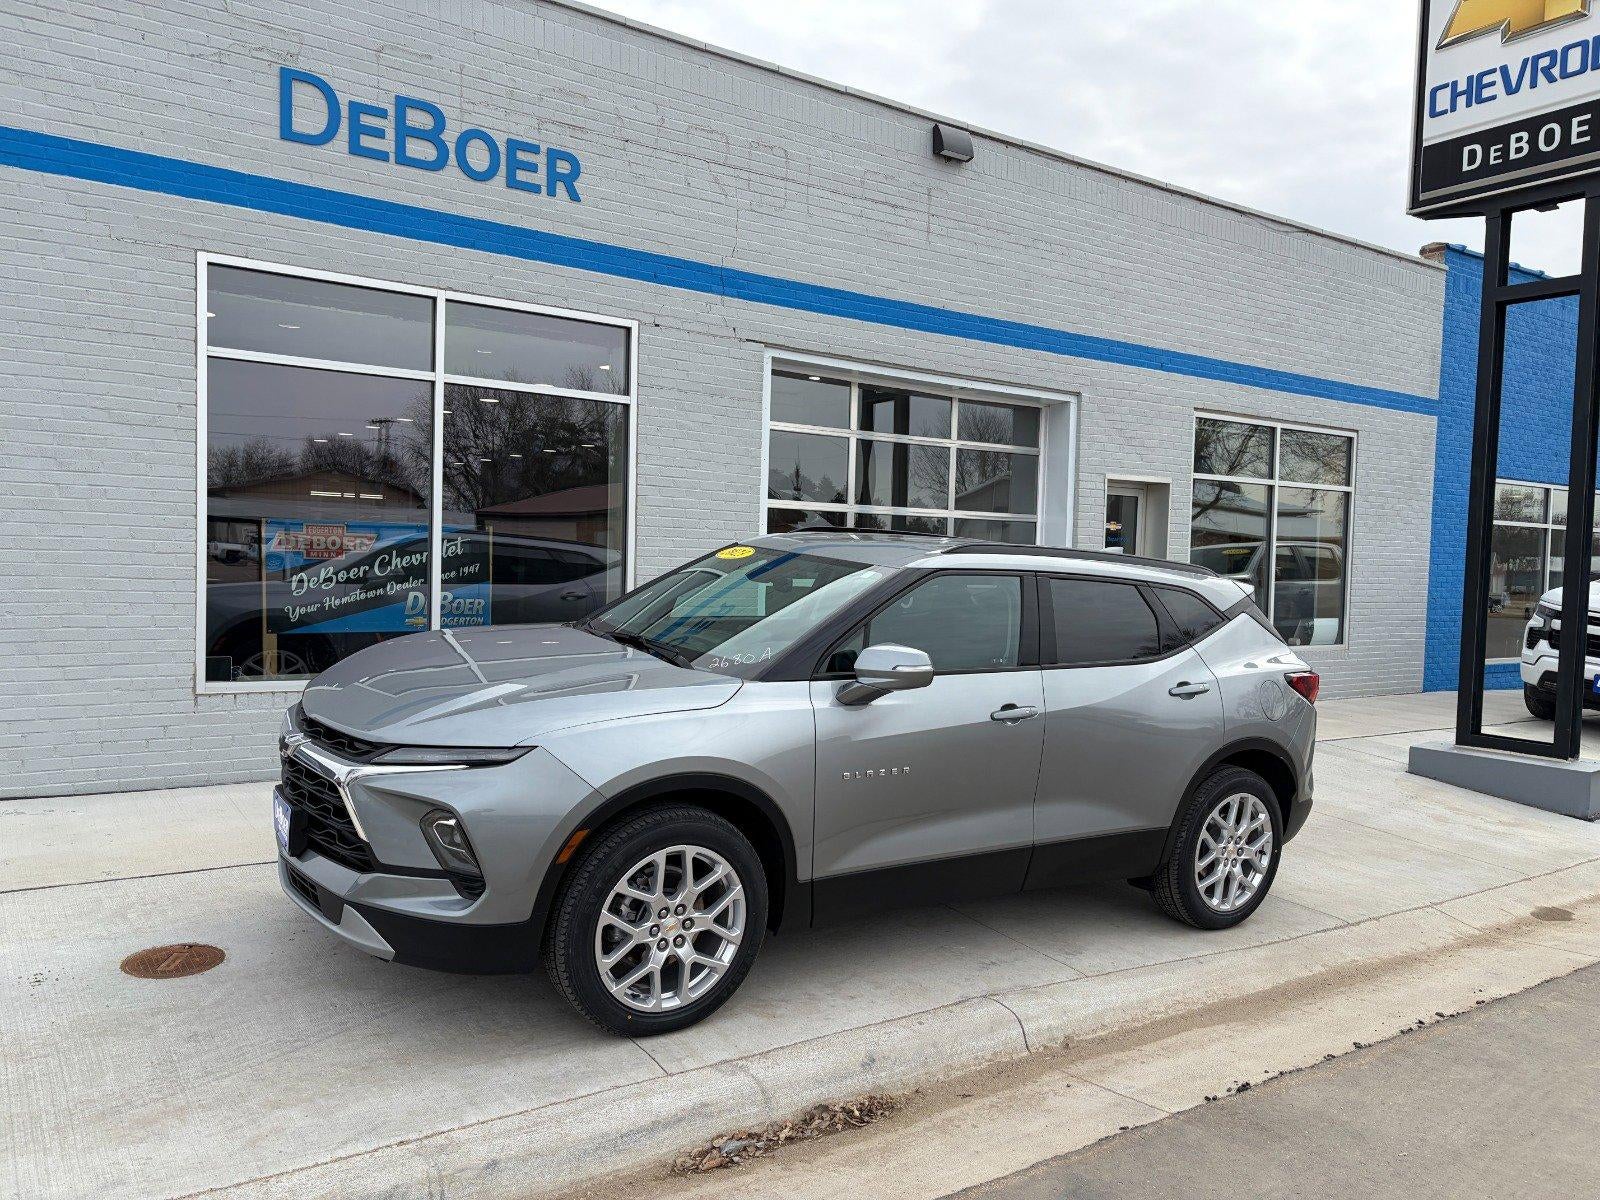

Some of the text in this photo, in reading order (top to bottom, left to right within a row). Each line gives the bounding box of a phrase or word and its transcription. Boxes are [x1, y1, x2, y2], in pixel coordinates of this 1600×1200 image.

[308, 526, 343, 534] EDGERTON
[291, 536, 471, 596] DeBoer Chevrlet
[284, 603, 321, 622] Your
[323, 587, 385, 611] Hometown
[386, 576, 425, 595] Dealer
[459, 563, 480, 577] 1947
[440, 616, 484, 626] DGERTON
[843, 766, 910, 780] BLAZER
